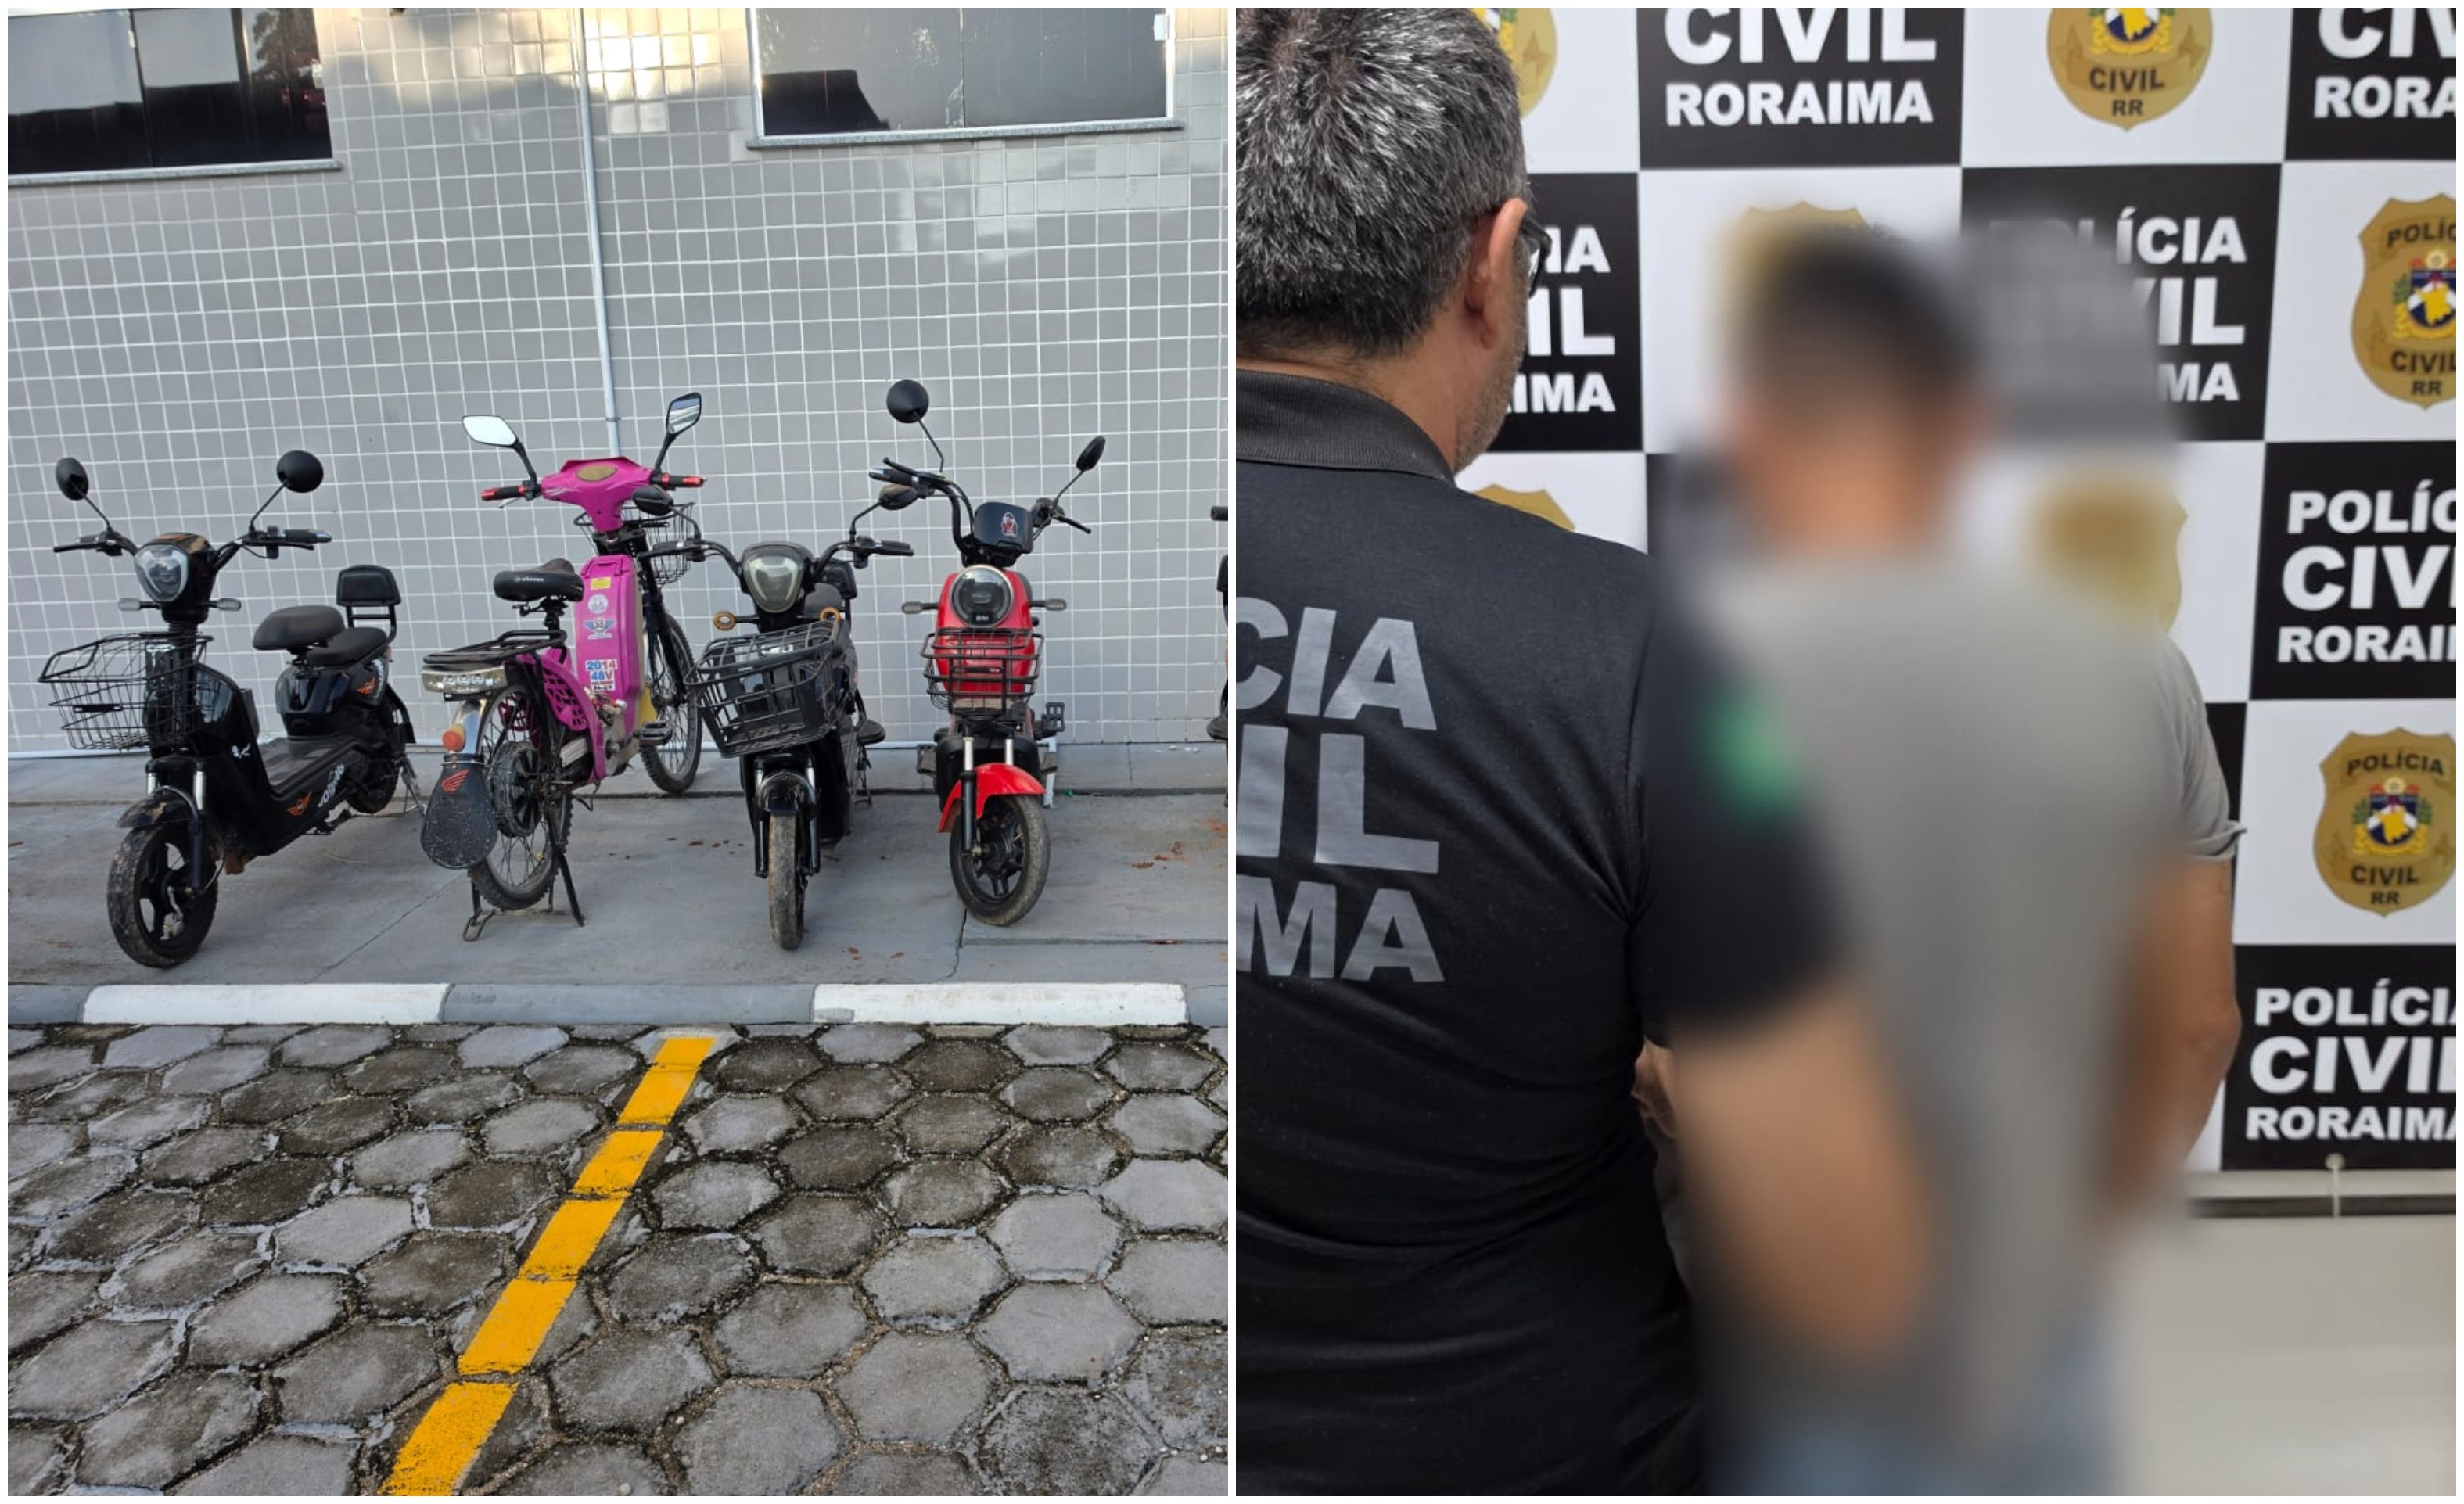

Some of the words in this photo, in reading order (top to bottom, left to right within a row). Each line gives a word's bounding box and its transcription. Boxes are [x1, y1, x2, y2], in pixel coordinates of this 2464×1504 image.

[1665, 8, 1936, 64] CIVIL
[2089, 67, 2165, 92] CIVIL
[1666, 81, 1934, 126] RORAIMA
[2112, 99, 2143, 117] RR
[2132, 277, 2245, 346] IL
[1506, 373, 1616, 414] IMA
[2412, 380, 2442, 396] RR
[2278, 625, 2456, 663] RORAI
[2347, 748, 2444, 776] POLÍCIA
[2351, 864, 2419, 885] CIVIL
[2371, 890, 2400, 905] RR
[2254, 978, 2456, 1026] POLÍCI
[2246, 1106, 2456, 1141] RORAIM
